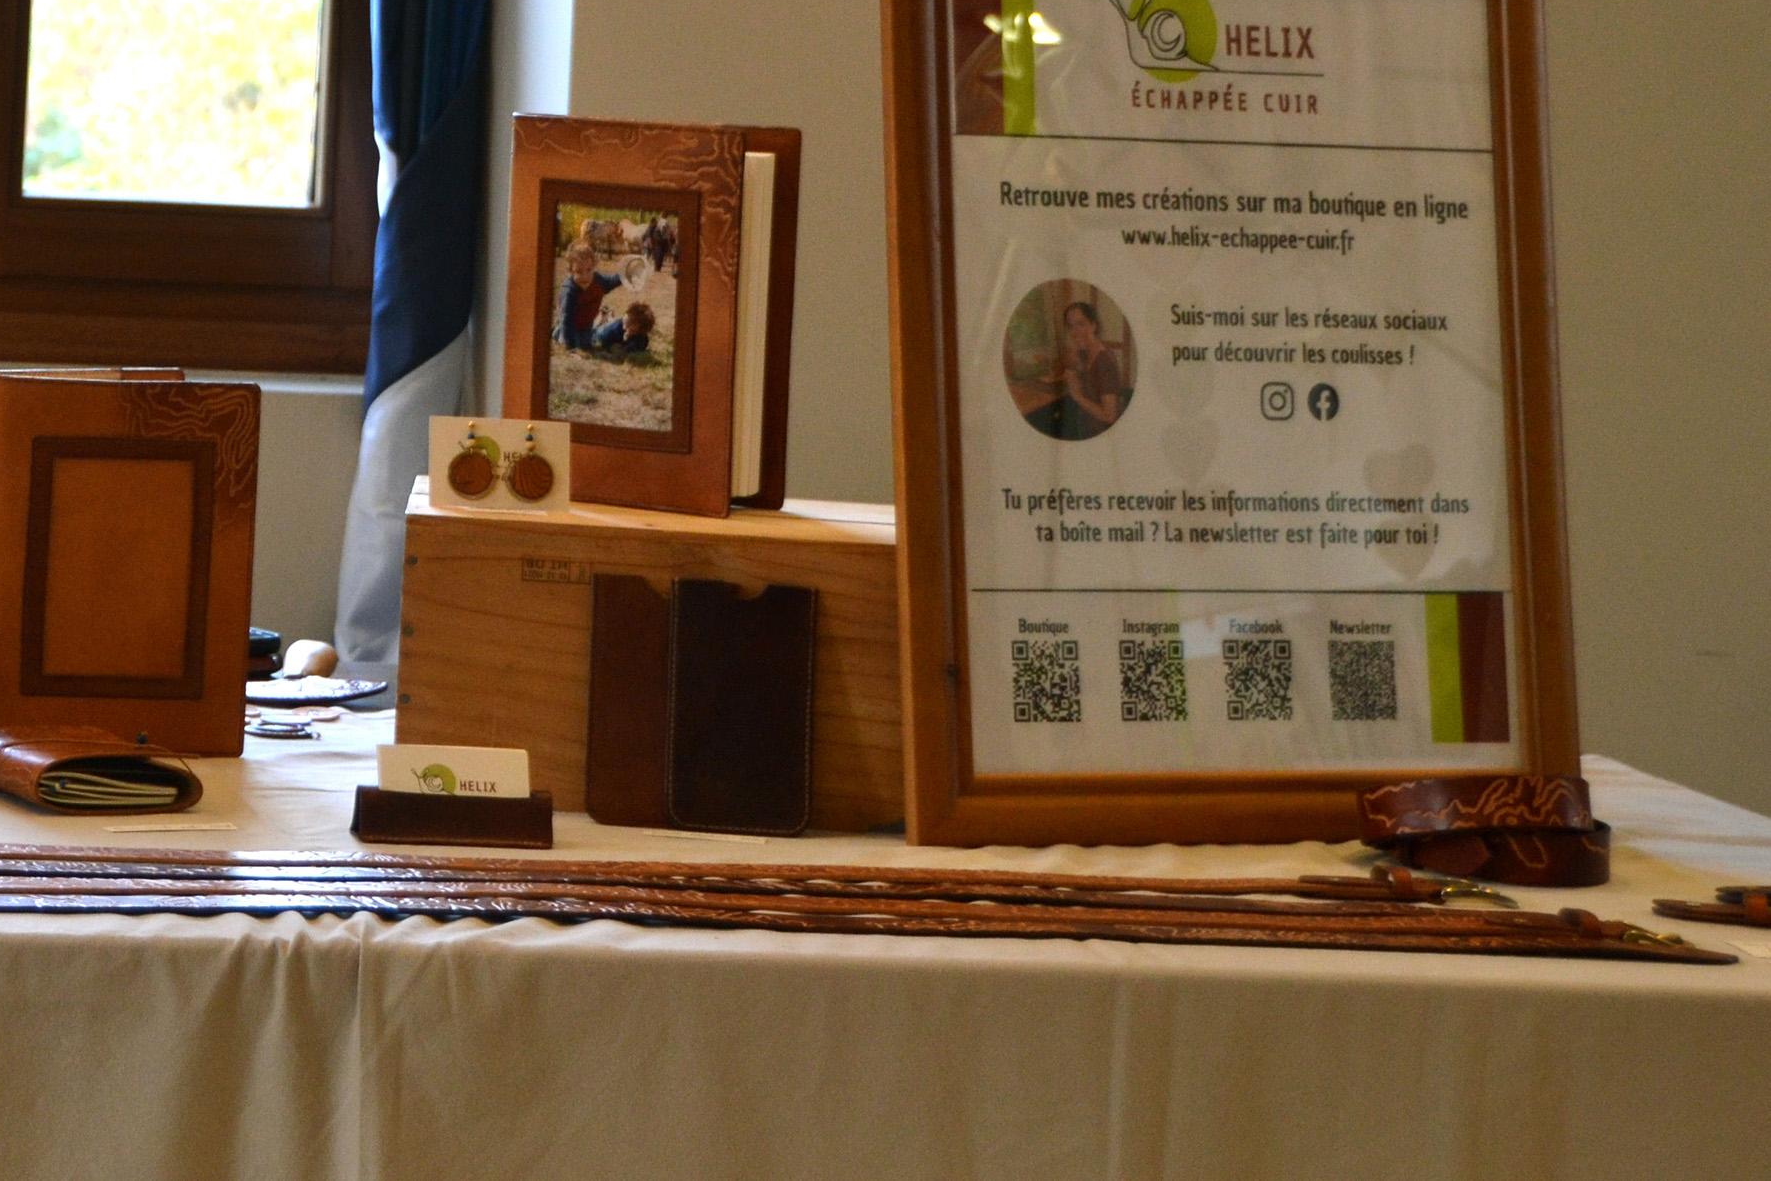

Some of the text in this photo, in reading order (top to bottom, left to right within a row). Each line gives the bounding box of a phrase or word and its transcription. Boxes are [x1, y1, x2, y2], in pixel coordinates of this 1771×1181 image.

[1225, 23, 1316, 60] HELIX
[1130, 79, 1320, 116] ÉCHAPPÉE CUIR
[999, 180, 1470, 225] Retrouve mes créations sur ma boutique en ligne
[1120, 226, 1356, 256] www.helix-echappee-cuir.fr
[1170, 303, 1449, 332] Suis-moi sur les réseaux sociaux
[1171, 340, 1416, 367] pour découvrir les coulisses !
[1000, 487, 1471, 518] Tu préfères recevoir les informations directement dans
[1034, 519, 1440, 549] ta boîte mail ? La newsletter est faite pour toi !
[1017, 617, 1070, 638] Boutique
[1121, 618, 1180, 638] Instagram
[1229, 618, 1285, 636] Facebook
[1329, 618, 1393, 636] Newsletter
[459, 780, 498, 794] HELIX
